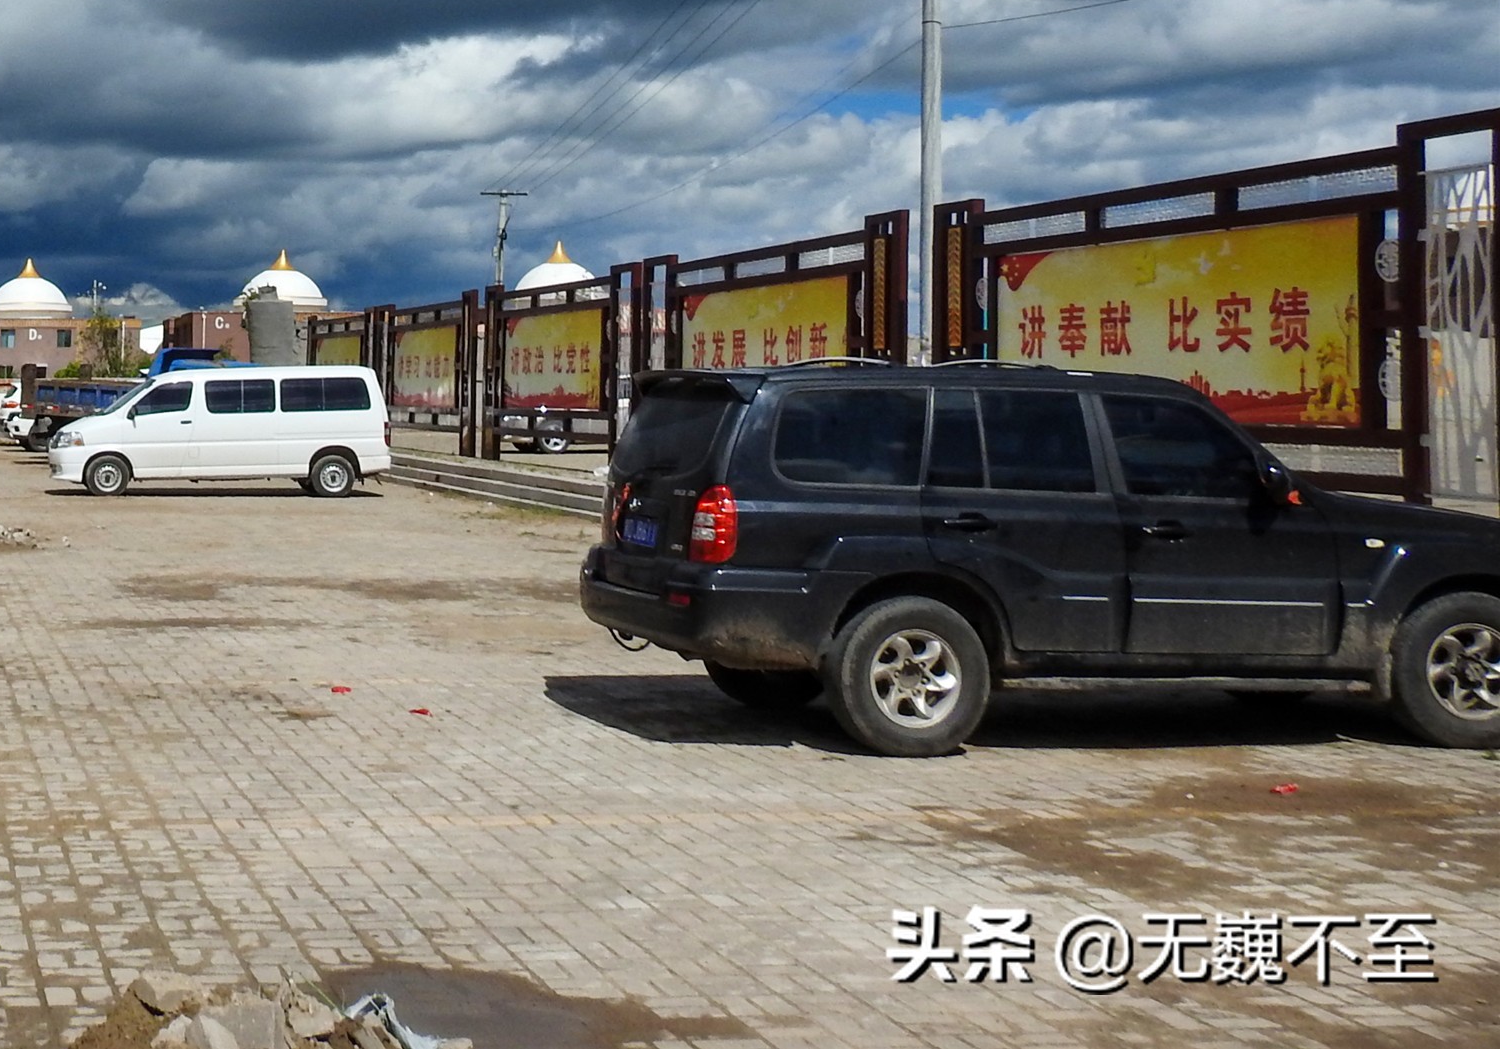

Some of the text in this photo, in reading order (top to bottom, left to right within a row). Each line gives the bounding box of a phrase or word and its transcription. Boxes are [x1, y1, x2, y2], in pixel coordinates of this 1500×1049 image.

[691, 322, 827, 369] 讲发展 比创新
[1019, 286, 1310, 359] 讲奉献 比实绩
[511, 341, 590, 375] 讲政治 比党性
